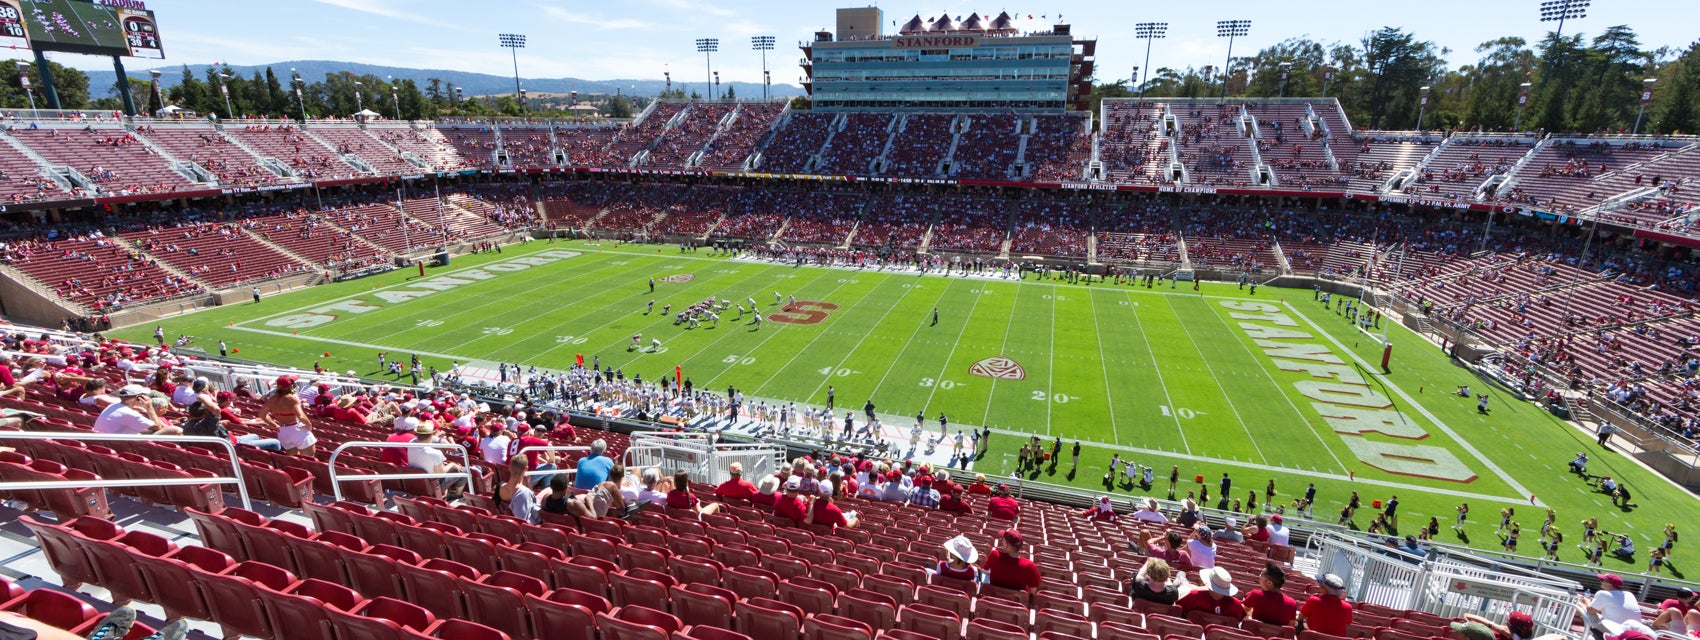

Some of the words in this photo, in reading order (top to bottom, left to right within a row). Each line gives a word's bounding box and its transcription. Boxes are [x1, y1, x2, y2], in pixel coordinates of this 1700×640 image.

[0, 6, 17, 19] 38
[8, 27, 23, 36] 10
[130, 21, 138, 32] 0
[131, 38, 142, 46] 39
[896, 36, 974, 48] STANFORD
[263, 249, 584, 328] STANFORD
[765, 299, 841, 327] S
[555, 335, 589, 345] 30
[722, 355, 757, 366] 50
[817, 366, 852, 377] 40
[919, 377, 955, 390] 30
[1031, 390, 1069, 404] 20
[1218, 300, 1479, 484] STANFORD
[1159, 405, 1196, 419] 10
[510, 438, 520, 456] 8
